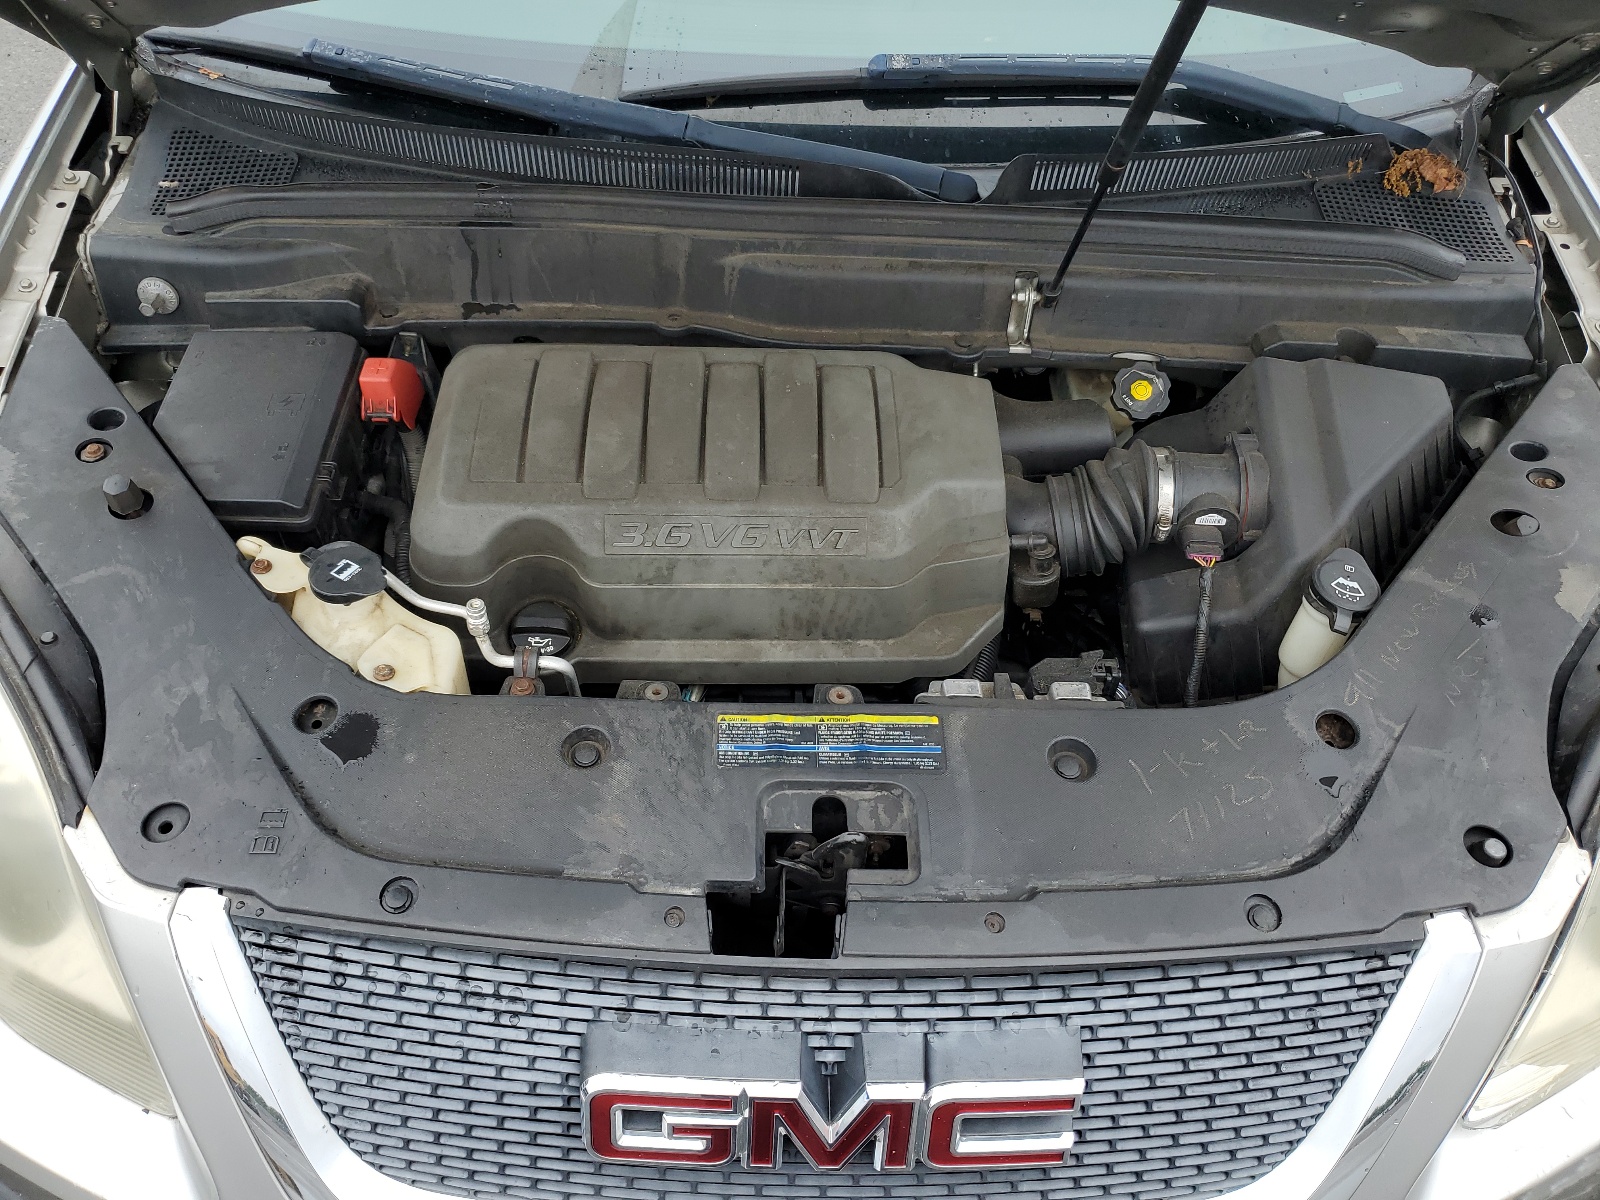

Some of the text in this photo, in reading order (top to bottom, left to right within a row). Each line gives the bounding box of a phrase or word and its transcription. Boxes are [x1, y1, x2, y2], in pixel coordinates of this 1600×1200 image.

[611, 521, 860, 550] 3.6 V6 VVT
[580, 1074, 1084, 1172] GMC
